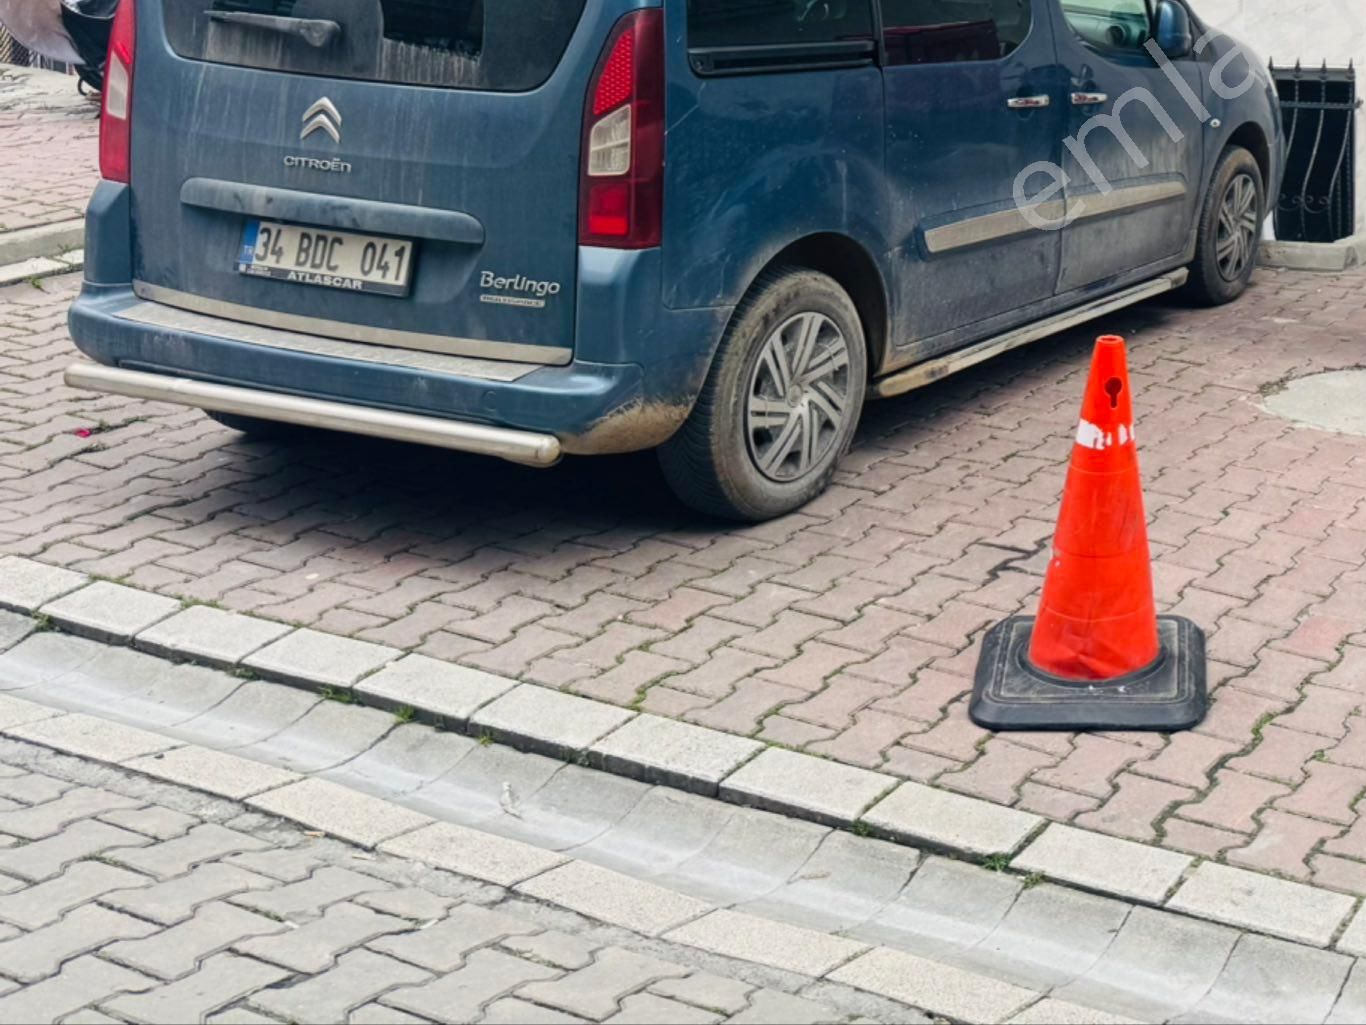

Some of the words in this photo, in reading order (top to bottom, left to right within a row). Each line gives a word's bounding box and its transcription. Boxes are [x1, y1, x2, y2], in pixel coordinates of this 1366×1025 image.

[255, 227, 284, 265] 34
[295, 231, 344, 273] BDC
[360, 240, 406, 282] 041
[287, 270, 363, 290] ATLASCAR
[480, 270, 560, 296] Berlingo
